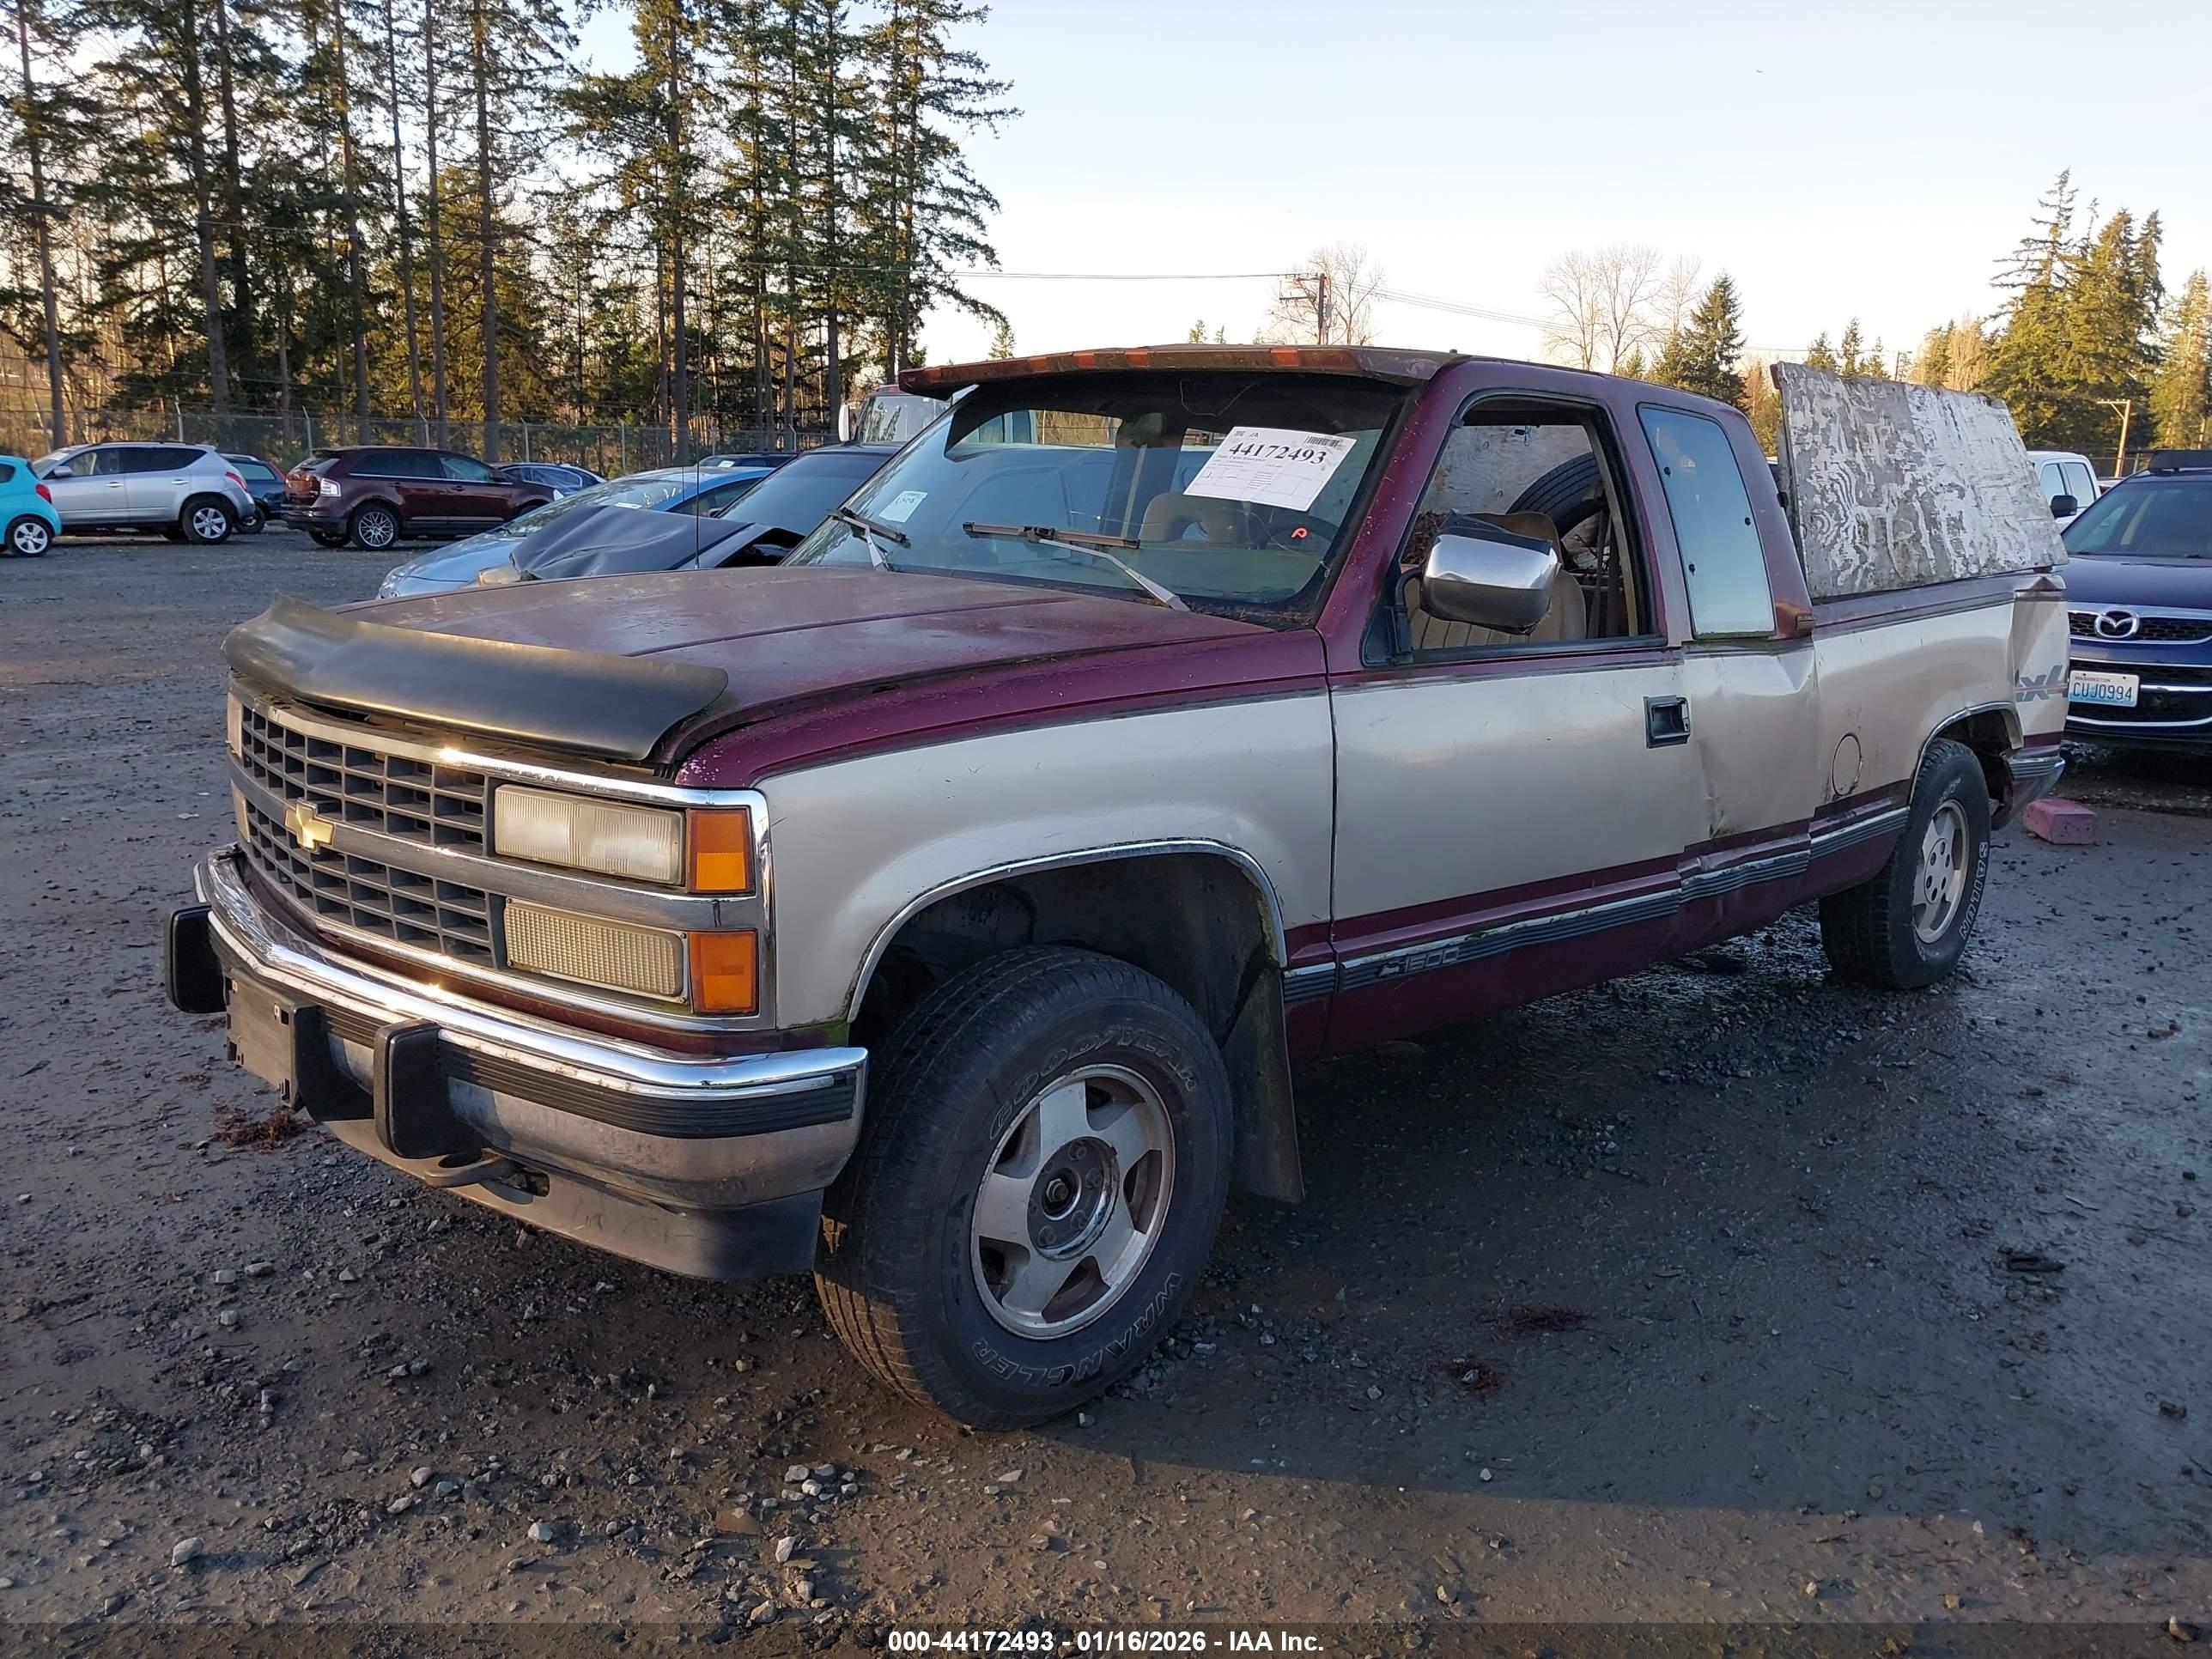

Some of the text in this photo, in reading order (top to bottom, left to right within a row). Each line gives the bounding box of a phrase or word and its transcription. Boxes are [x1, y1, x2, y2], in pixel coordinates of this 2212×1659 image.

[1229, 441, 1327, 465] 44172493
[2073, 682, 2132, 702] CUJ0994
[1959, 842, 1990, 941] SAILUN
[988, 1023, 1199, 1141] GOODYEAR
[971, 1271, 1183, 1389] WRANGLER
